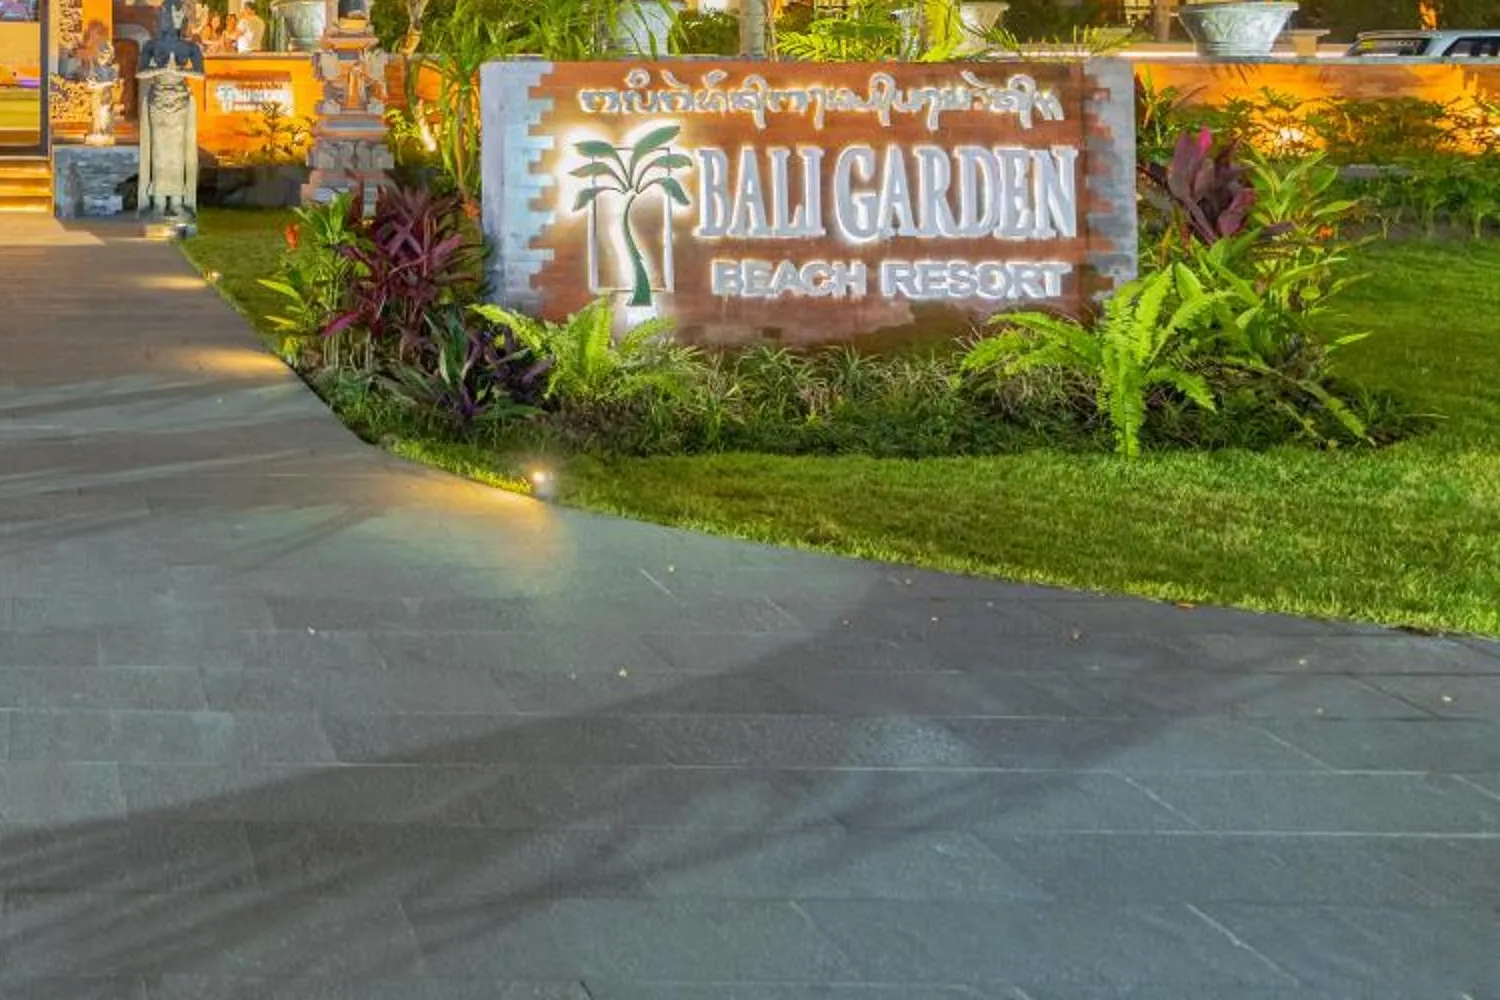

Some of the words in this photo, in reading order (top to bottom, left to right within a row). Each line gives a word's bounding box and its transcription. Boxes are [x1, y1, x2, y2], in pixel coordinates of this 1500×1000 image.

[694, 145, 826, 239] BALI
[833, 144, 1079, 245] GARDEN
[711, 260, 867, 299] BEACH
[880, 260, 1073, 299] RESORT
